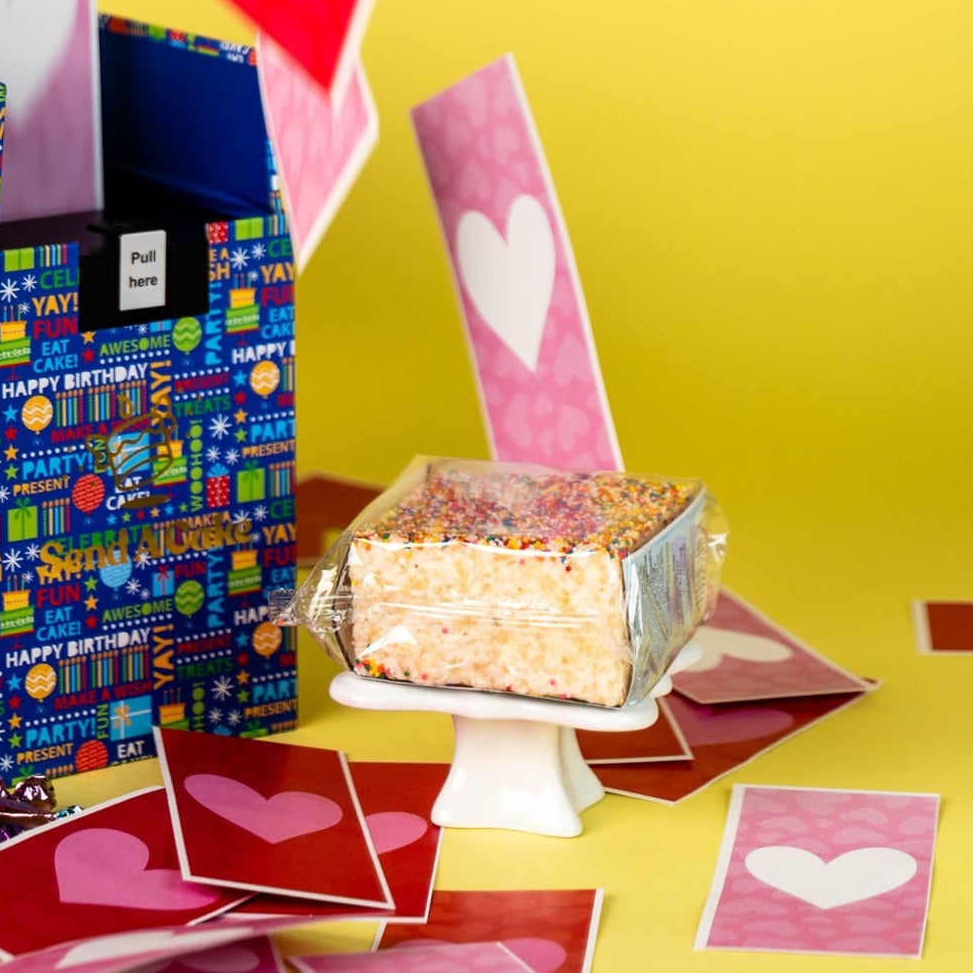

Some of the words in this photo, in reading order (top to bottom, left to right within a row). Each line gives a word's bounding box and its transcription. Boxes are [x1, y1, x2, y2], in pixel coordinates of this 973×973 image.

[131, 250, 156, 264] Pull
[40, 268, 79, 289] CEL
[129, 275, 158, 288] here
[32, 291, 79, 317] YAY!
[33, 316, 77, 340] FUN
[205, 282, 222, 365] PARTY!
[42, 339, 70, 356] EAT
[99, 335, 170, 357] AWESOME
[232, 343, 286, 364] HAPPY
[33, 354, 77, 373] CAKE!
[2, 376, 60, 399] HAPPY
[64, 363, 148, 390] BIRTHDAY
[175, 396, 231, 418] TREATS
[242, 440, 295, 458] PRESENT
[22, 452, 93, 479] PARTY!
[190, 419, 203, 512] WOOHOO!
[13, 475, 70, 497] PRESENT
[40, 528, 128, 573] Send
[133, 521, 164, 562] A
[174, 561, 206, 581] FUN
[37, 585, 80, 608] FUN
[45, 607, 73, 625] EAT
[102, 599, 173, 623] AWESOME
[37, 621, 81, 642] CAKE!
[6, 644, 64, 668] HAPPY
[67, 628, 151, 657] BIRTHDAY
[153, 624, 174, 690] YAY!
[54, 690, 96, 710] MAKE
[101, 689, 110, 701] A
[244, 699, 298, 719] PRESENT
[27, 717, 96, 748] PARTY!
[97, 704, 109, 740] FUN
[17, 743, 74, 765] PRESENT
[117, 740, 145, 758] EAT
